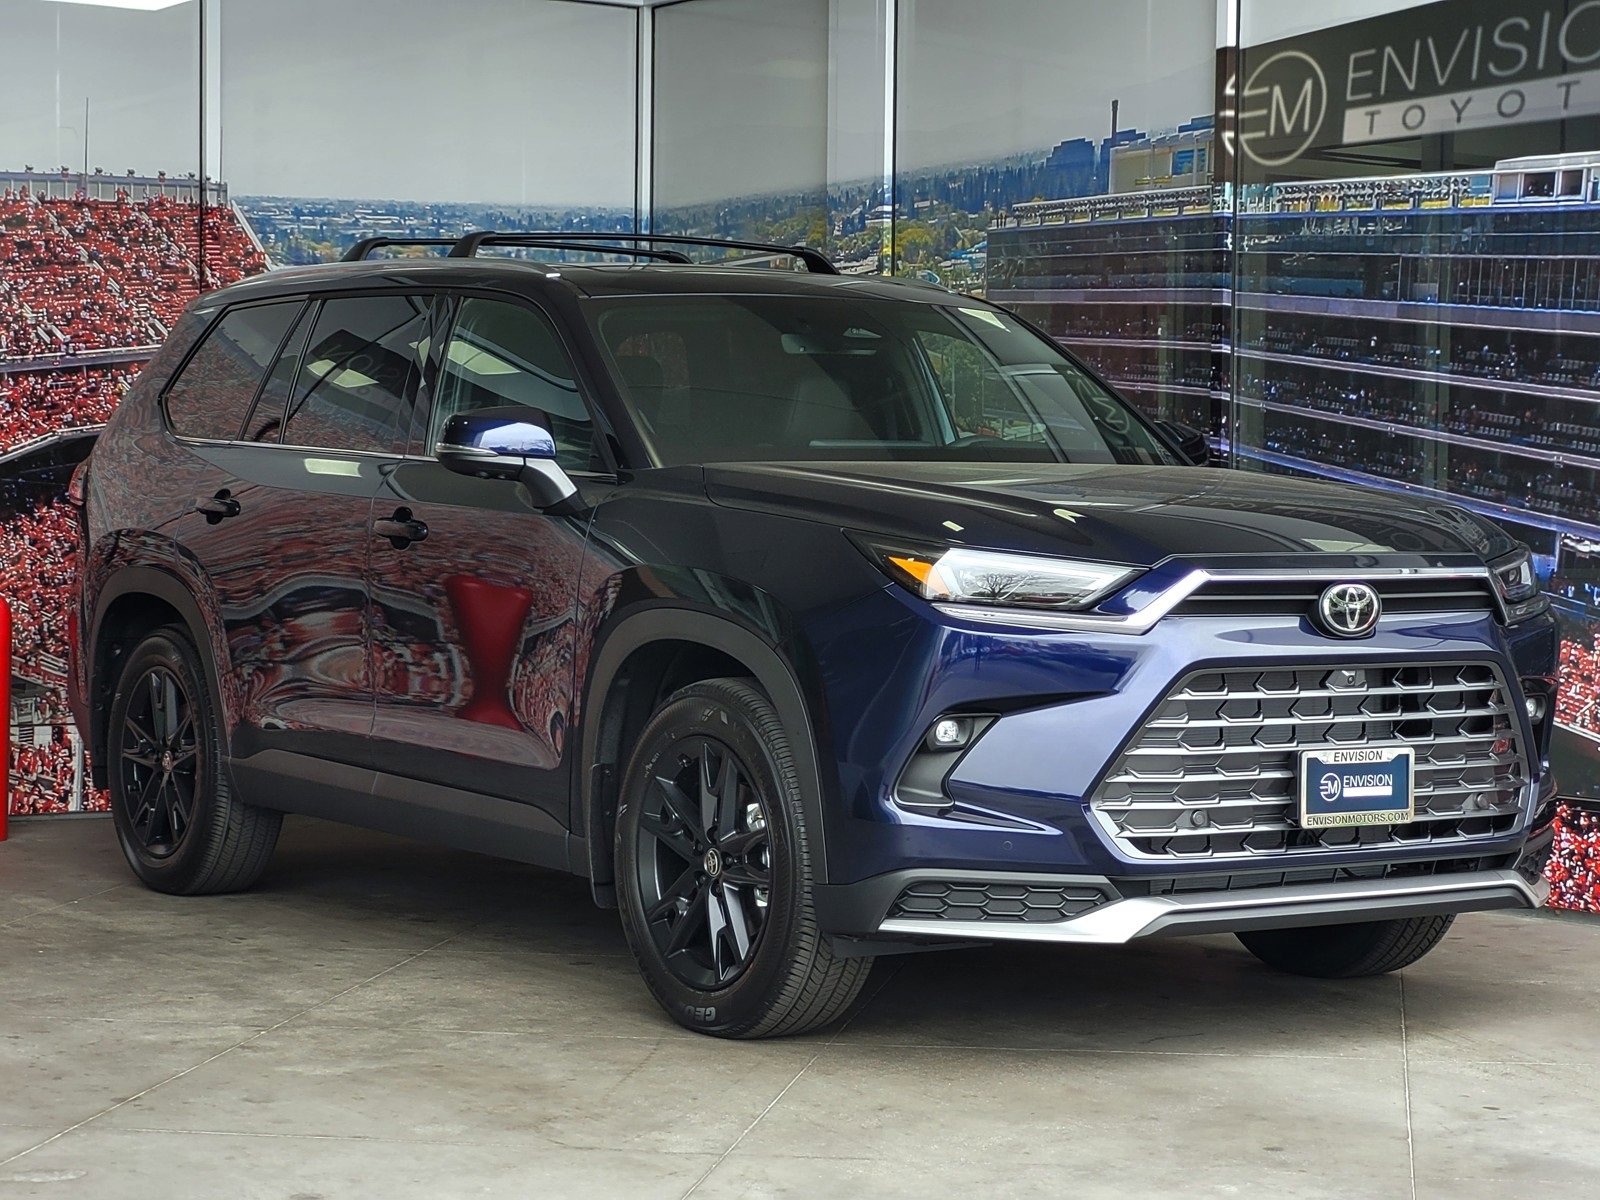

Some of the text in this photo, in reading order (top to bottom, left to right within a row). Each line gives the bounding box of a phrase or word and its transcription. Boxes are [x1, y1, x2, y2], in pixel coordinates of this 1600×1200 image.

[1333, 750, 1383, 762] ENVISION
[1343, 773, 1393, 787] ENVISION
[1307, 812, 1409, 826] ENVISIONMOTORS.COM
